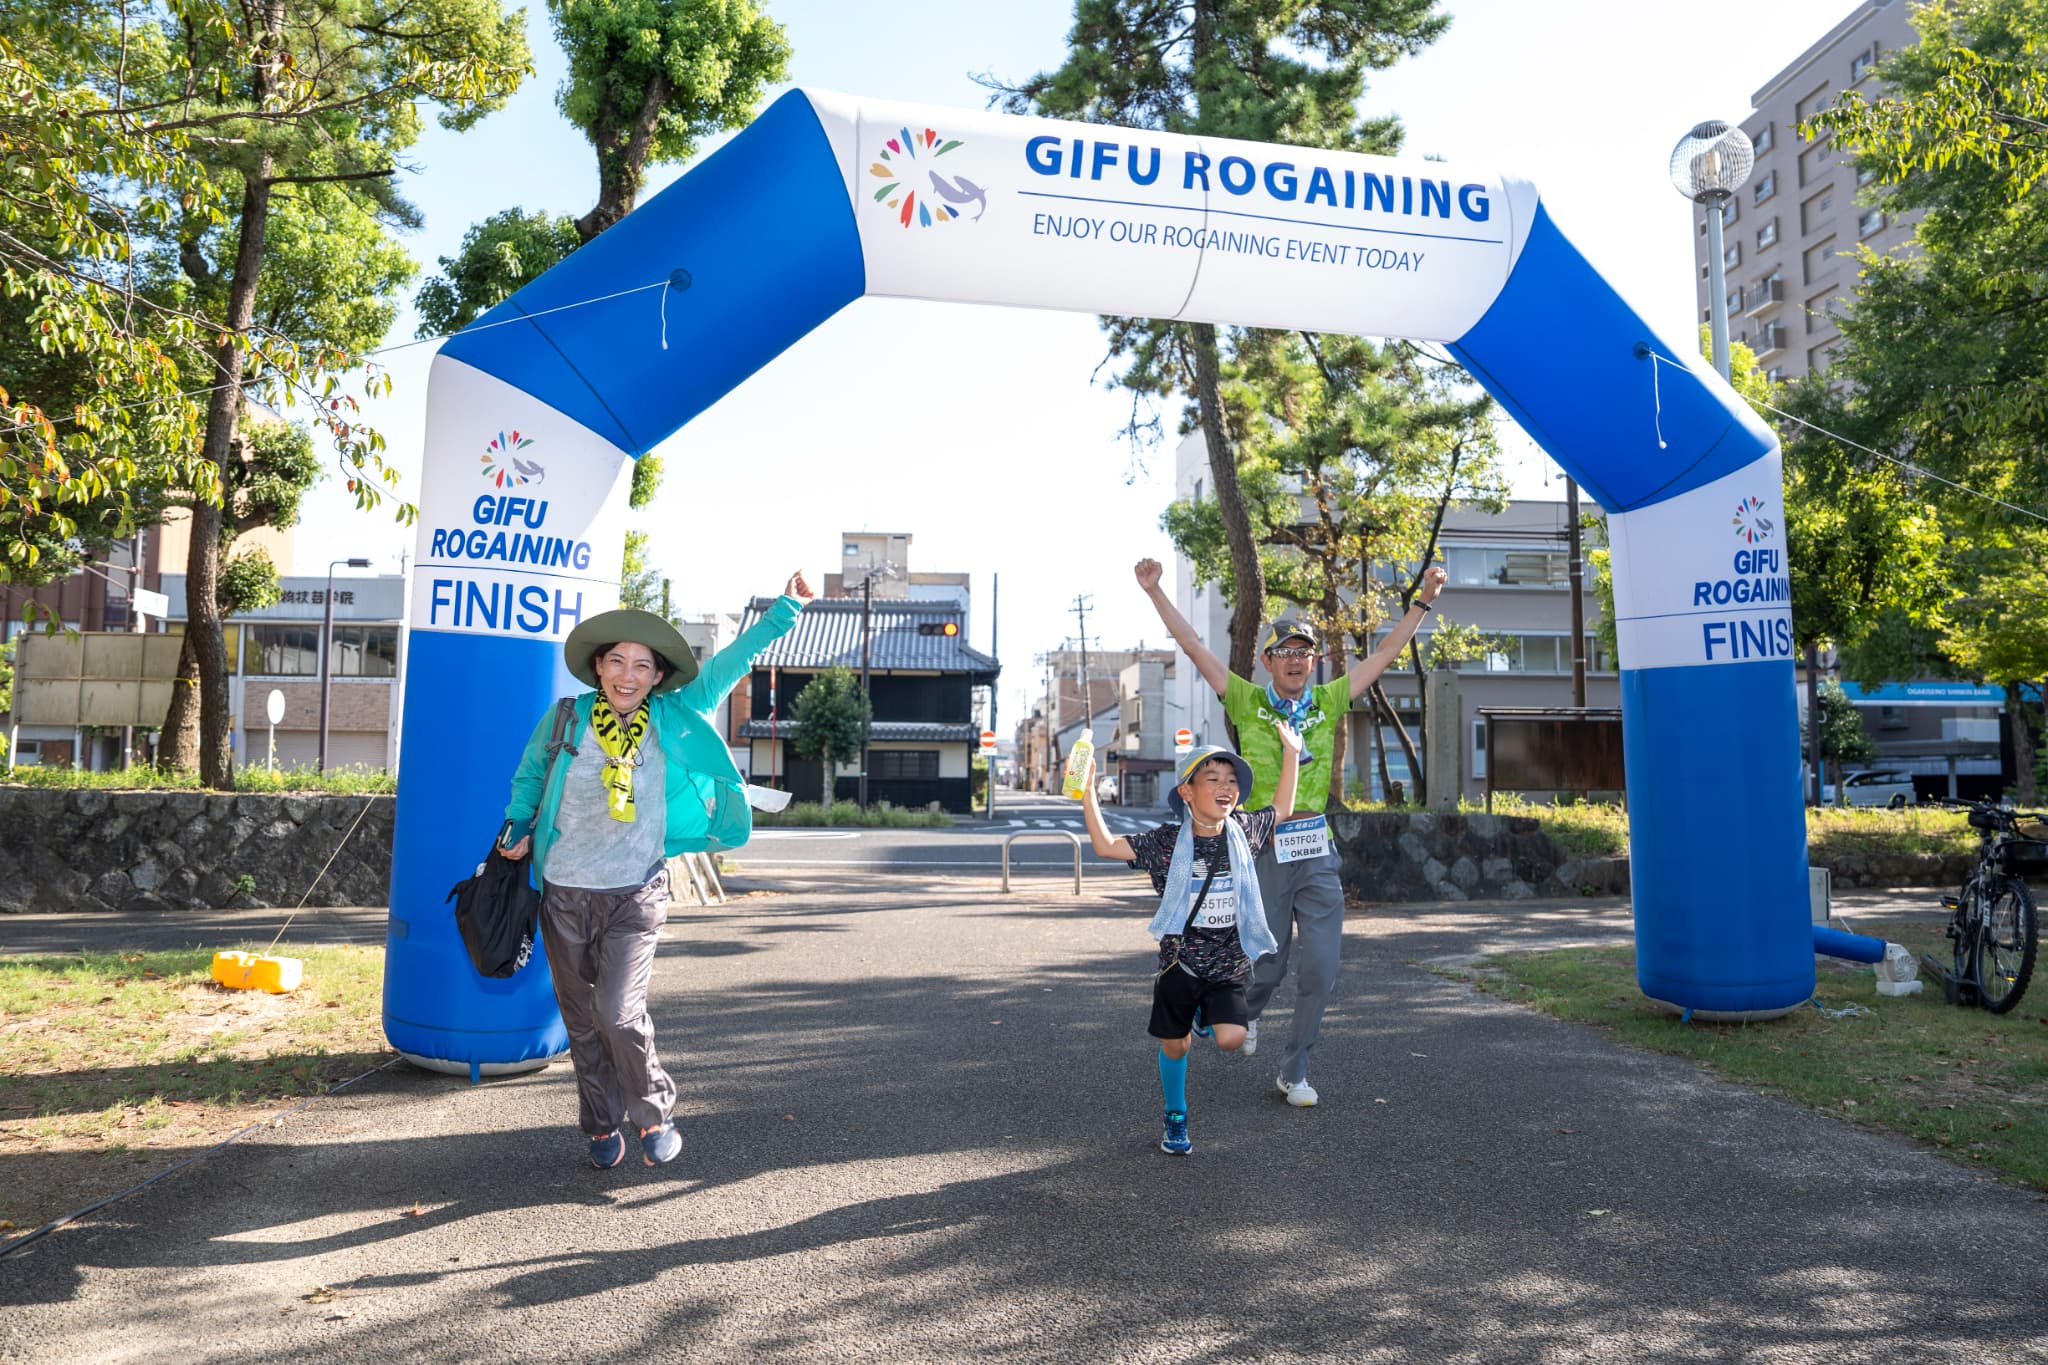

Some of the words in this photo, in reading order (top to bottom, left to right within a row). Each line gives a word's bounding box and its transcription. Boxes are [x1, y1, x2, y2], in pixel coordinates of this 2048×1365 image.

[1025, 135, 1161, 186] GIFU
[1183, 151, 1490, 222] ROGAINING
[1033, 213, 1105, 239] ENJOY
[1110, 221, 1157, 245] OUR
[1163, 225, 1280, 258] ROGAINING
[1286, 239, 1351, 265] EVENT
[1356, 247, 1424, 272] TODAY
[473, 494, 549, 529] GIFU
[430, 528, 592, 571] ROGAINING
[1734, 549, 1779, 575] GIFU
[430, 578, 583, 635] FINISH
[1693, 577, 1790, 606] ROGAININ
[1974, 687, 1991, 696] BANK
